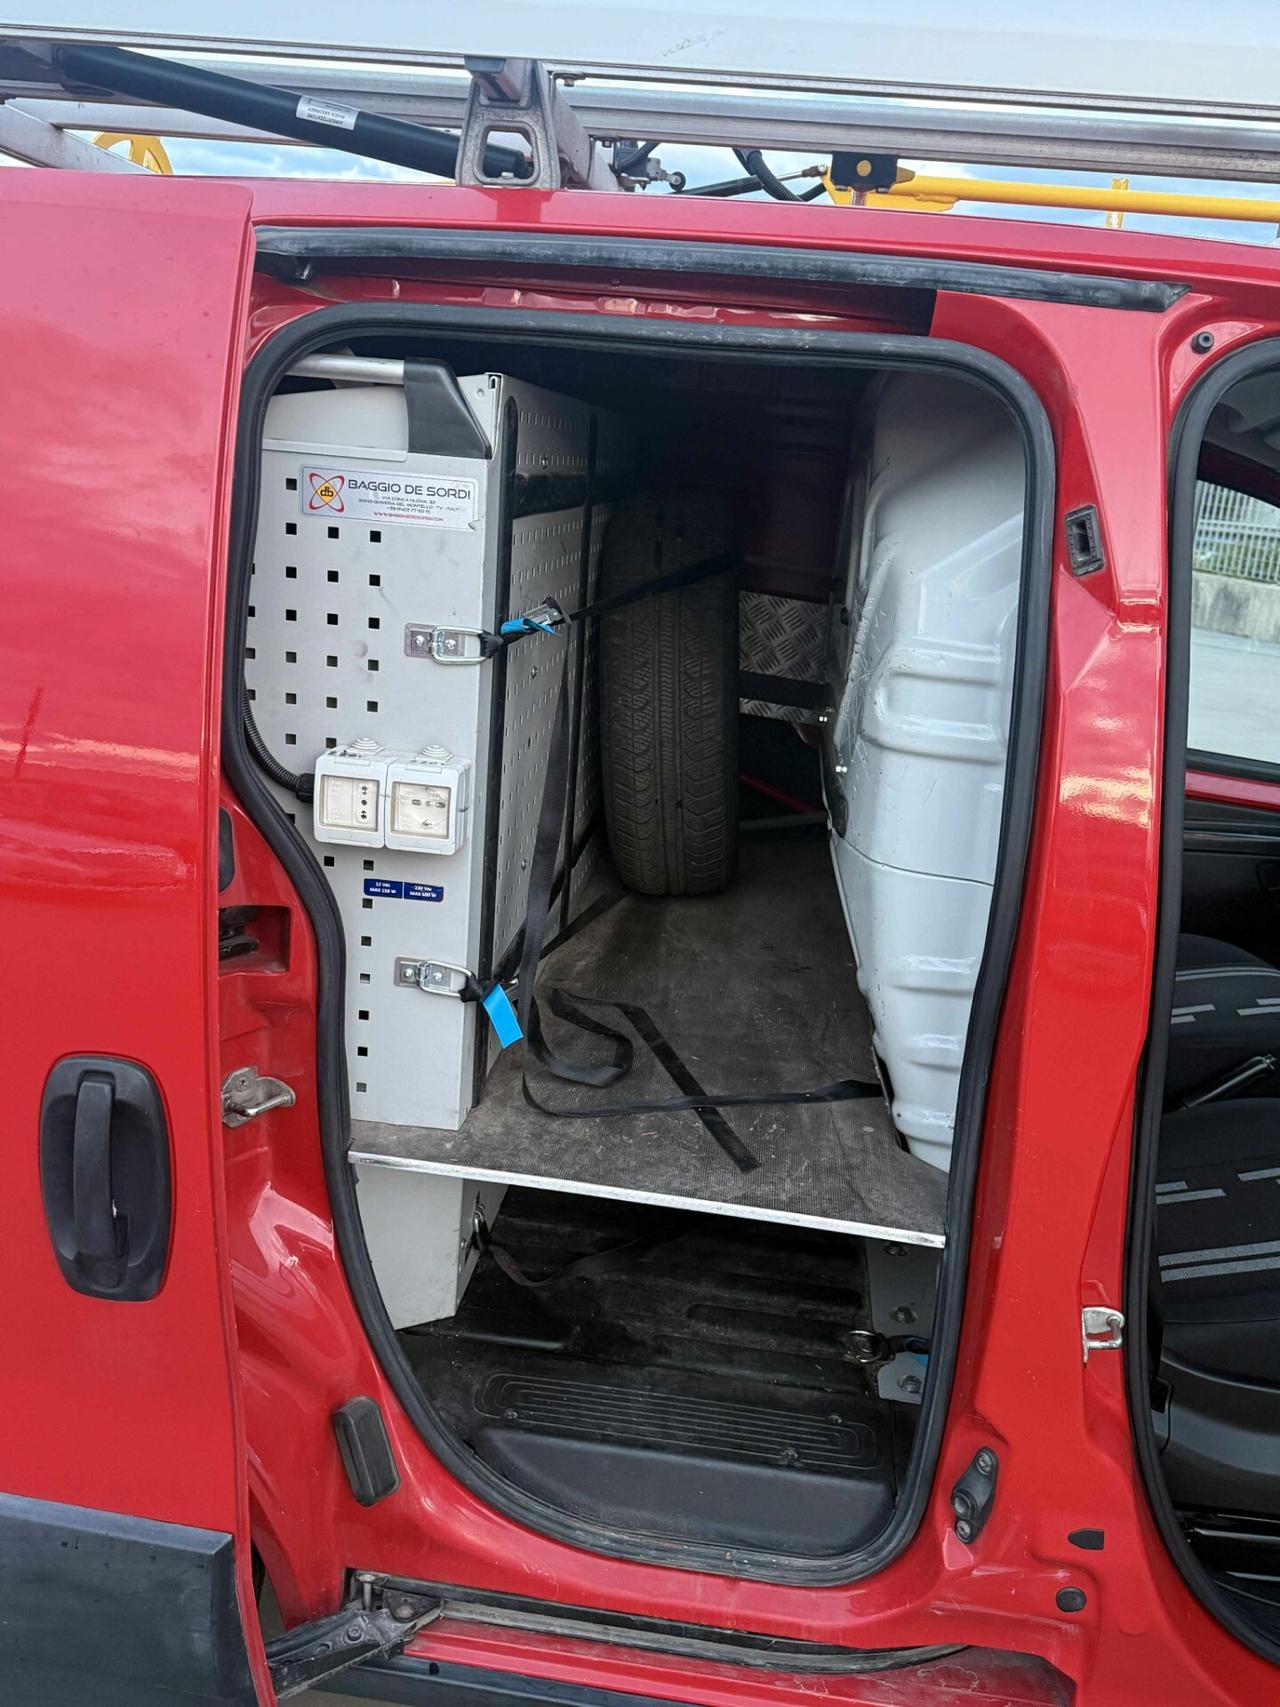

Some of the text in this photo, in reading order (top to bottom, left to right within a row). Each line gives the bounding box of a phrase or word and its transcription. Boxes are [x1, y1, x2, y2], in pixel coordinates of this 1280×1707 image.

[348, 479, 471, 500] BAGGIO DE SORDI
